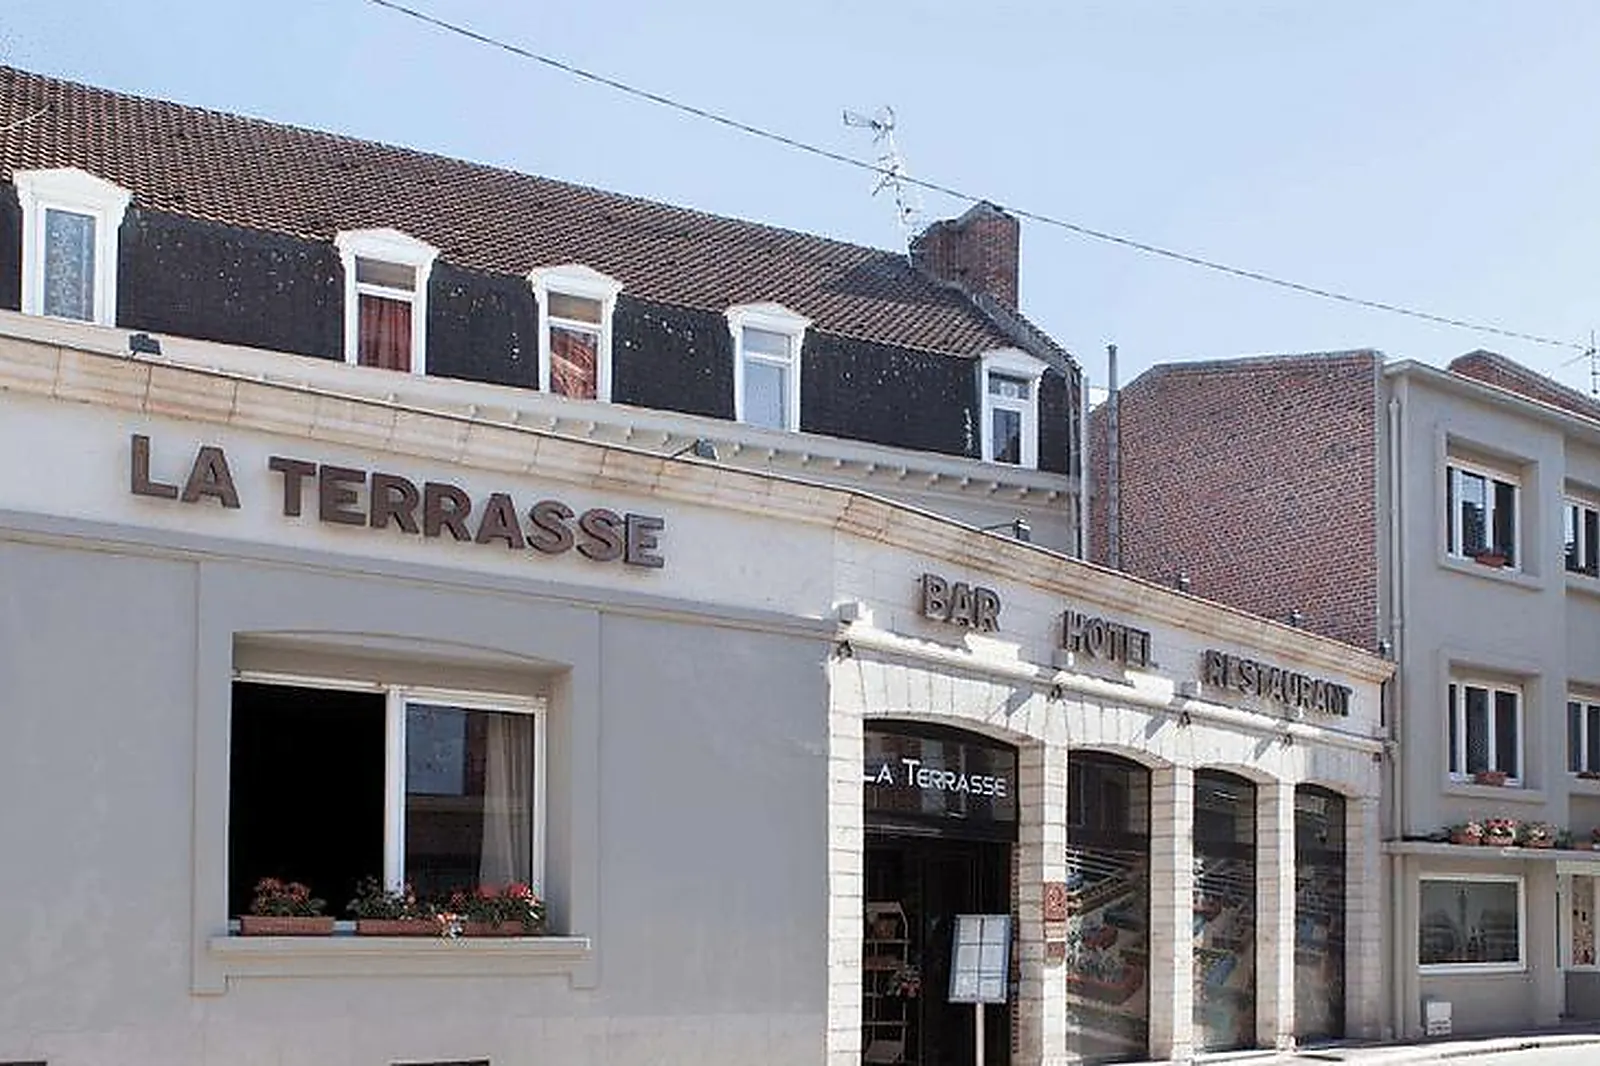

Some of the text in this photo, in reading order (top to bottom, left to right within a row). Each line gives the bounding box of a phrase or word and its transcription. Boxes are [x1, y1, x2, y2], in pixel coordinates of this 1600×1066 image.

[131, 434, 664, 569] LA TERRASSE
[922, 573, 1353, 717] BAR HOTEL RESTAURANT
[901, 758, 1007, 798] TERRASSE
